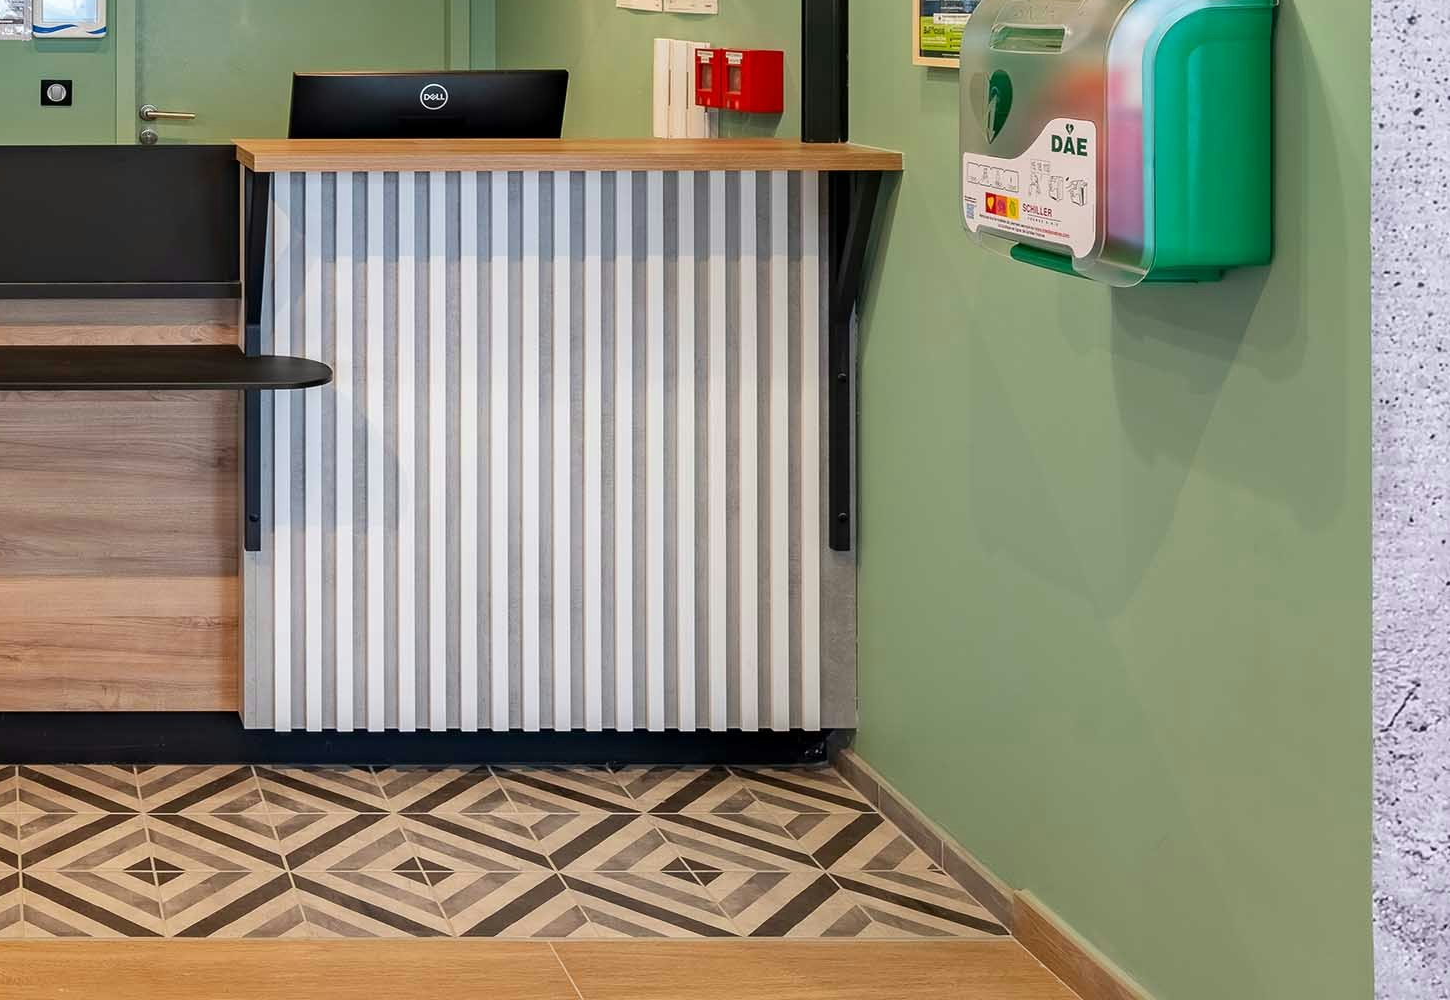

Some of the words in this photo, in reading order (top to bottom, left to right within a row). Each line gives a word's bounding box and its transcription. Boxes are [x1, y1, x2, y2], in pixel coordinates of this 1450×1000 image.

[424, 93, 445, 101] DELL
[1051, 135, 1088, 156] DAE
[1022, 203, 1053, 217] SCHILLER
